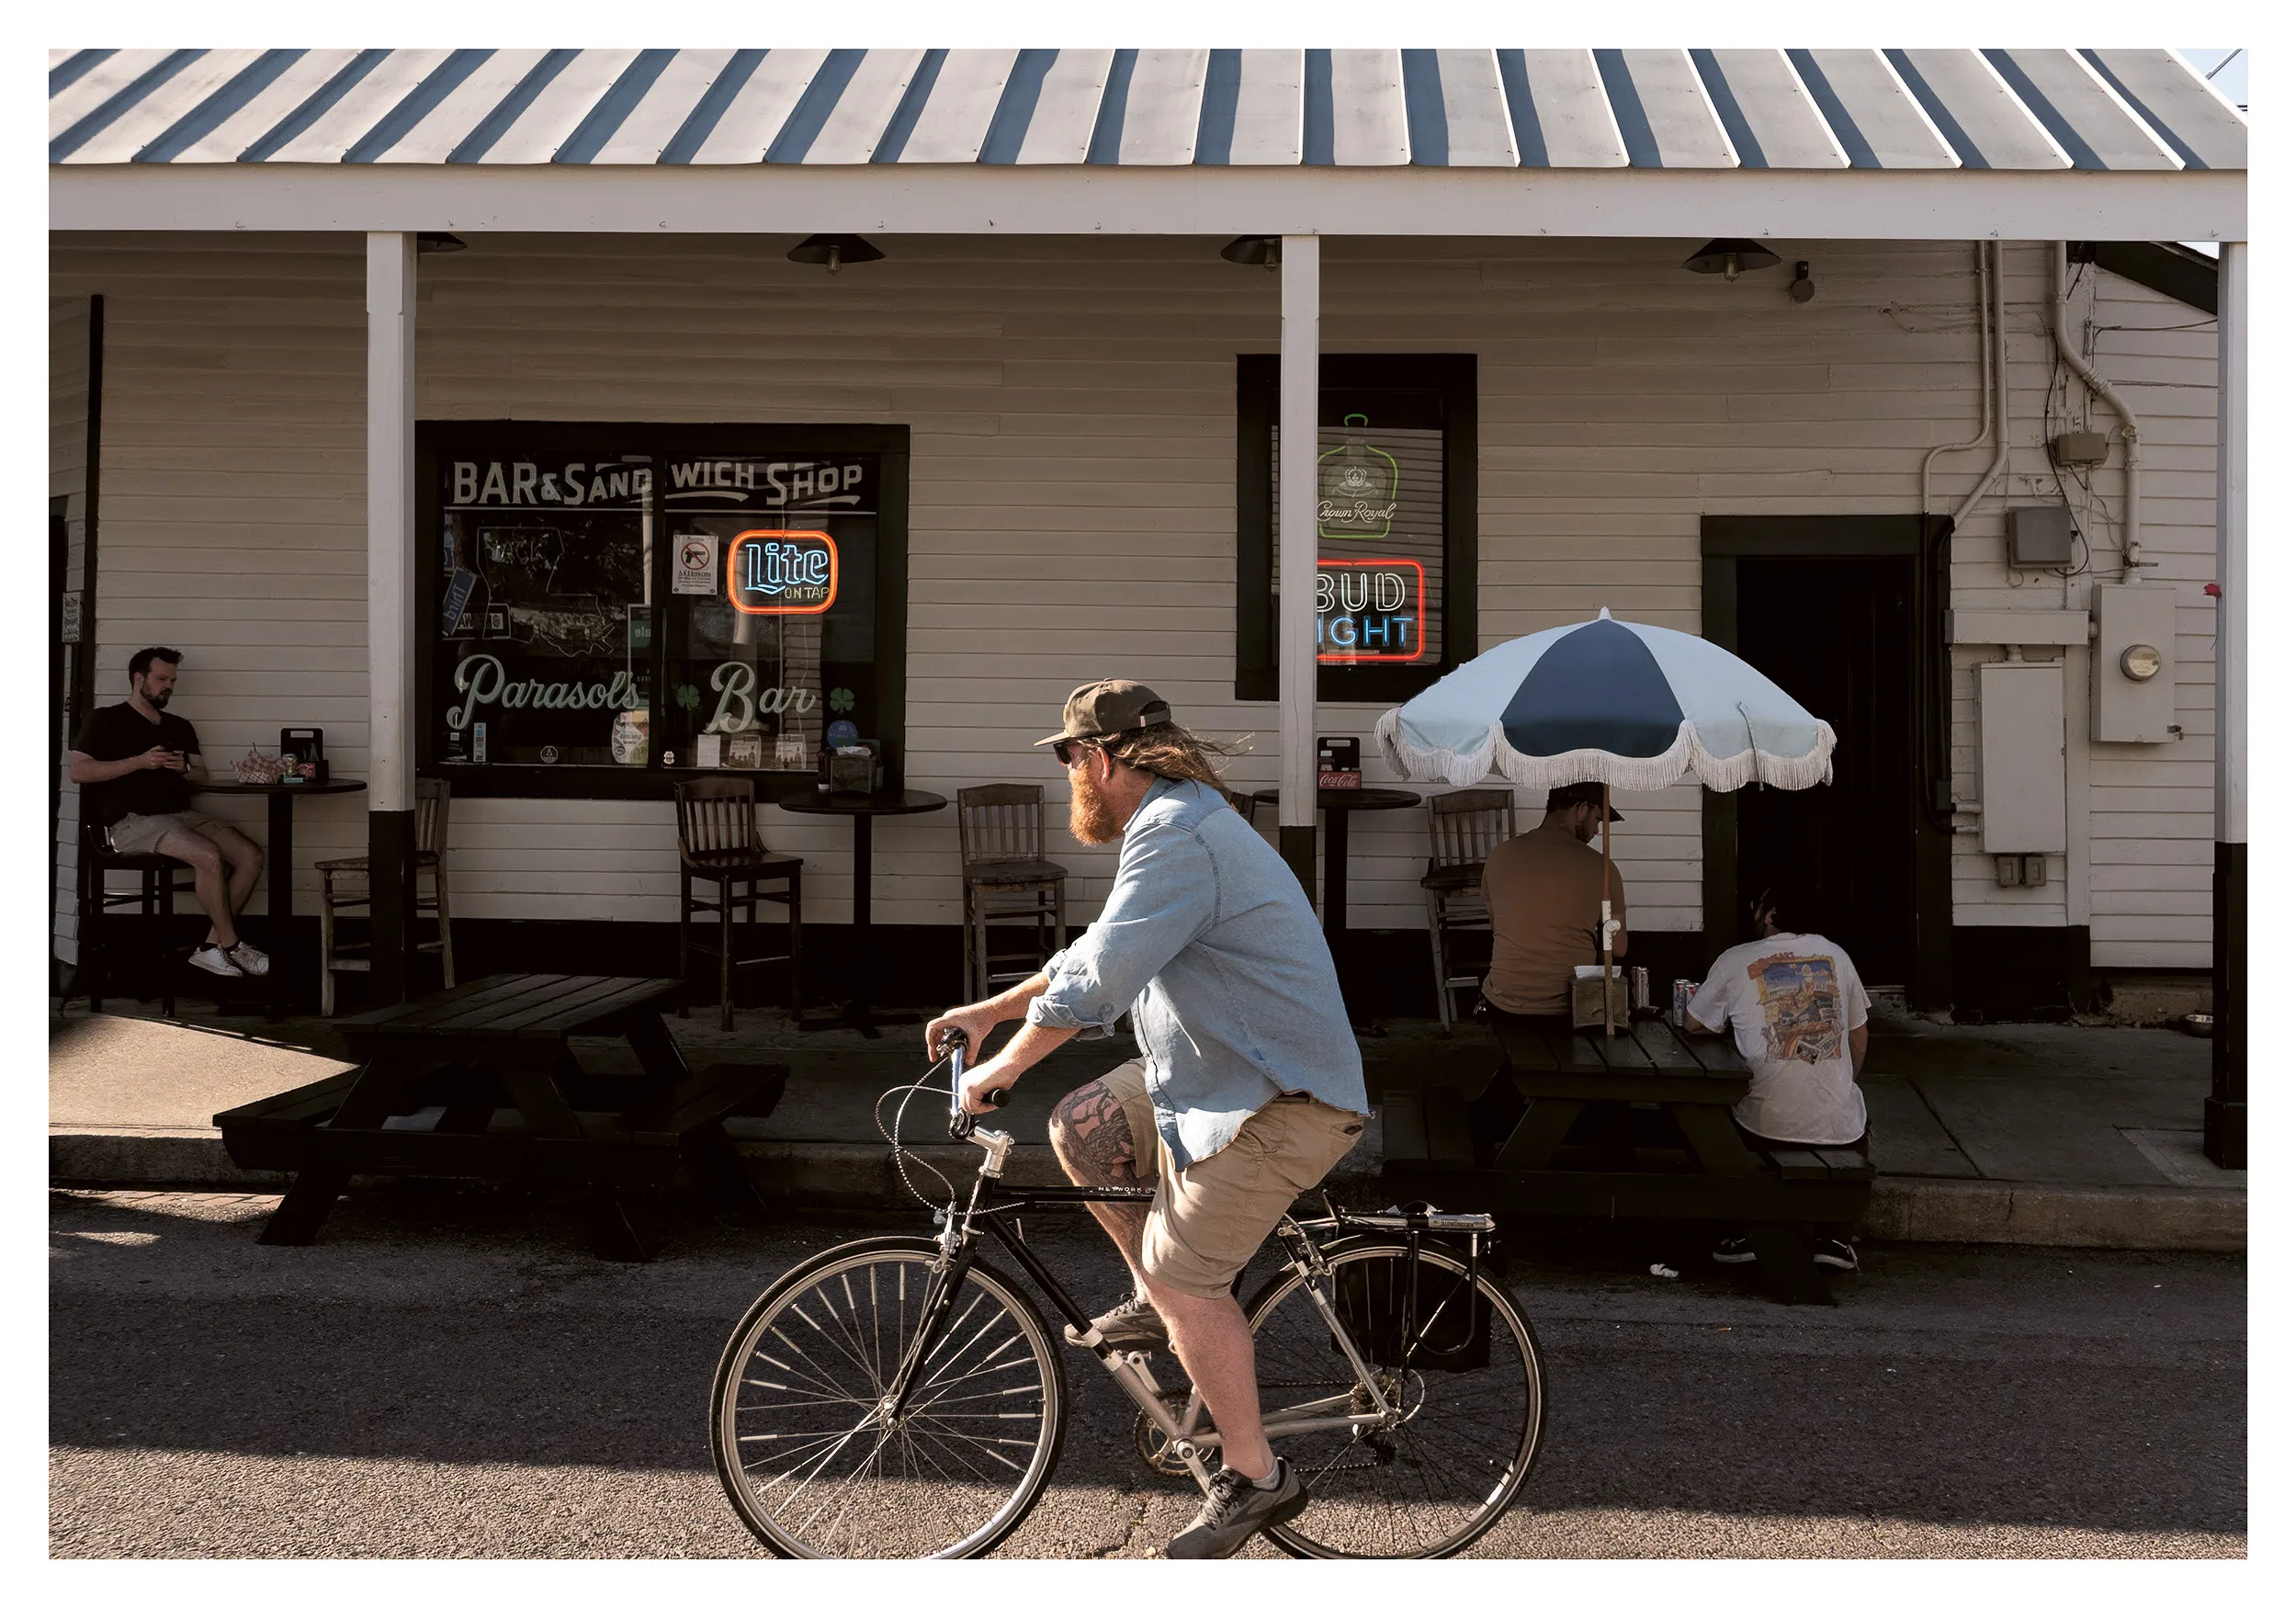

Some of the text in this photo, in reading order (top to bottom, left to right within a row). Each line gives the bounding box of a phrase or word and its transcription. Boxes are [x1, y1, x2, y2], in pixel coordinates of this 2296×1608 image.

[766, 462, 863, 505] SHOP
[1317, 500, 1397, 524] Crown Royal
[745, 542, 829, 595] Lite
[785, 587, 830, 599] ON TAP
[1317, 572, 1406, 613] BUD
[1317, 616, 1415, 647] IGHT
[446, 653, 817, 734] Parasol's Bar
